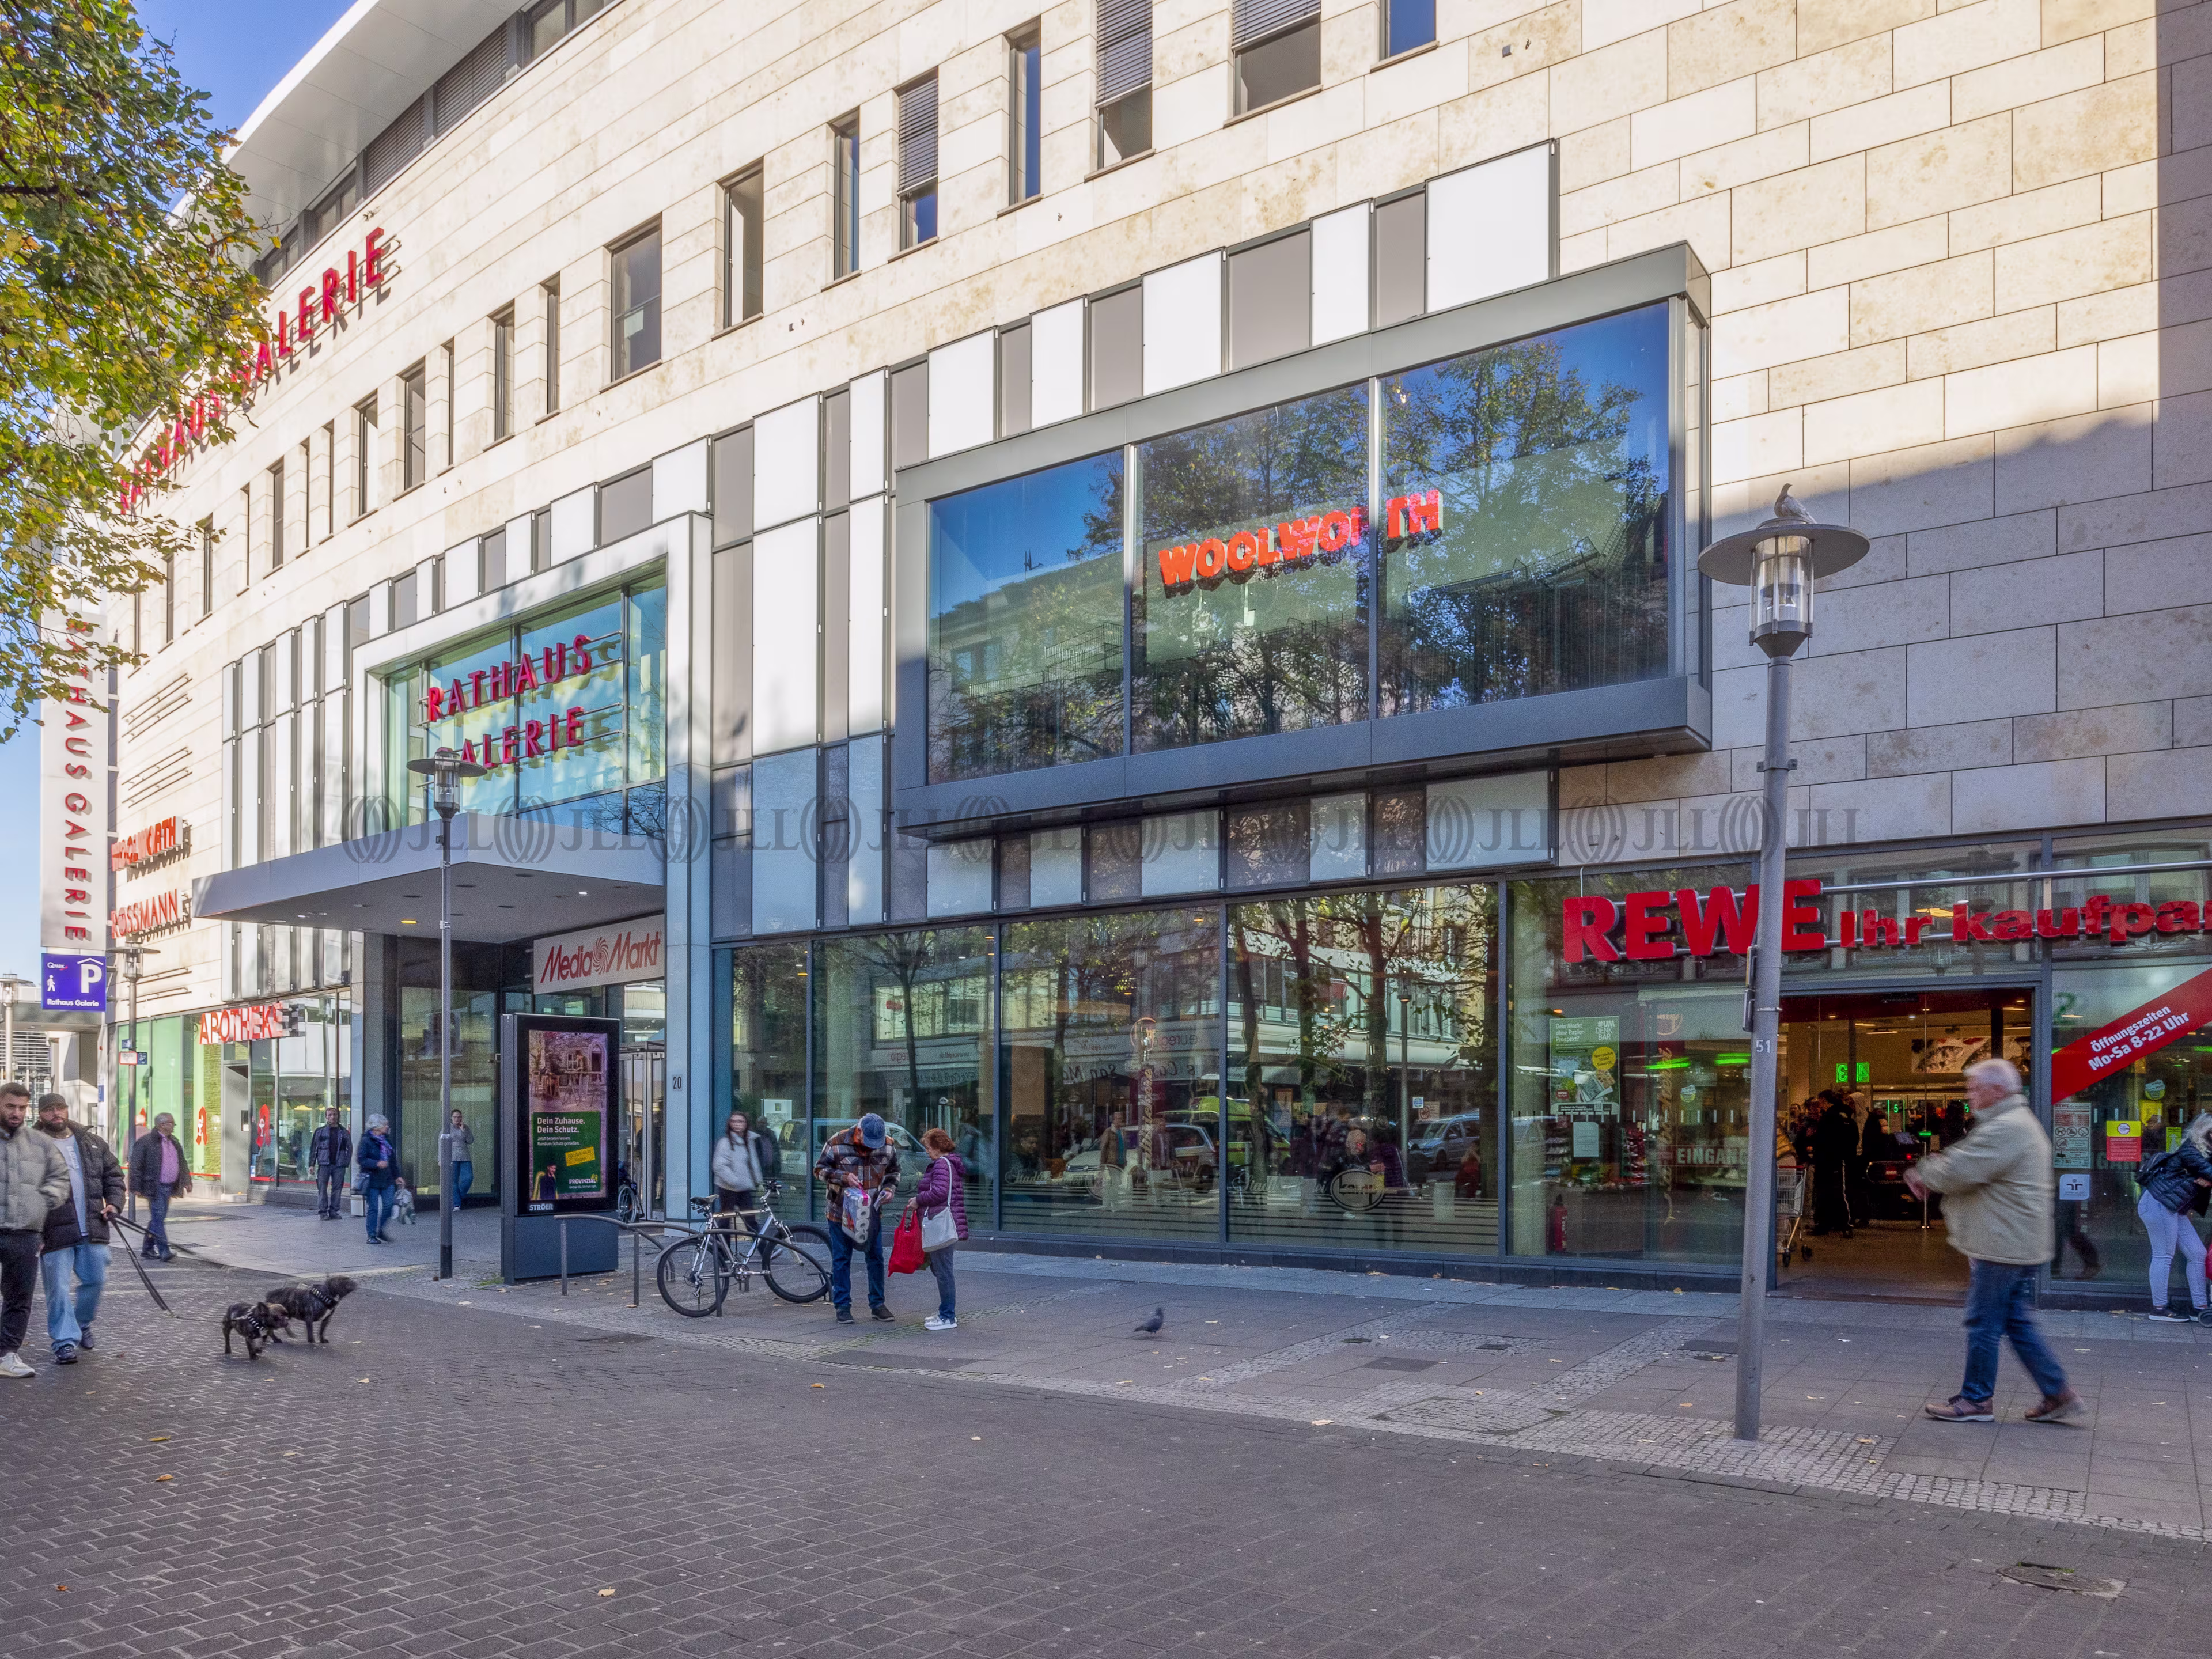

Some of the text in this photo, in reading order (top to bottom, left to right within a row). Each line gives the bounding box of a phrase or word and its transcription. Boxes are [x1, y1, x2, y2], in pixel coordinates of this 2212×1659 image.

[232, 227, 384, 396] ALERIE
[427, 634, 593, 722] RATHAUS
[460, 706, 585, 769] ALERIE
[65, 793, 86, 940] GALERIE
[111, 889, 178, 939] ROSSMANN
[1563, 879, 2212, 963] REWE Ihr kaufpa
[81, 964, 102, 994] P
[199, 1001, 283, 1045] APOTHEKE
[1756, 1039, 1770, 1053] 51
[2088, 1012, 2189, 1071] Mo-Sa 8-22 Uhr
[2090, 1006, 2171, 1052] Öffnungszeiten
[673, 1076, 681, 1089] 20
[1893, 1104, 1899, 1113] 5
[529, 1203, 553, 1211] STRÖER
